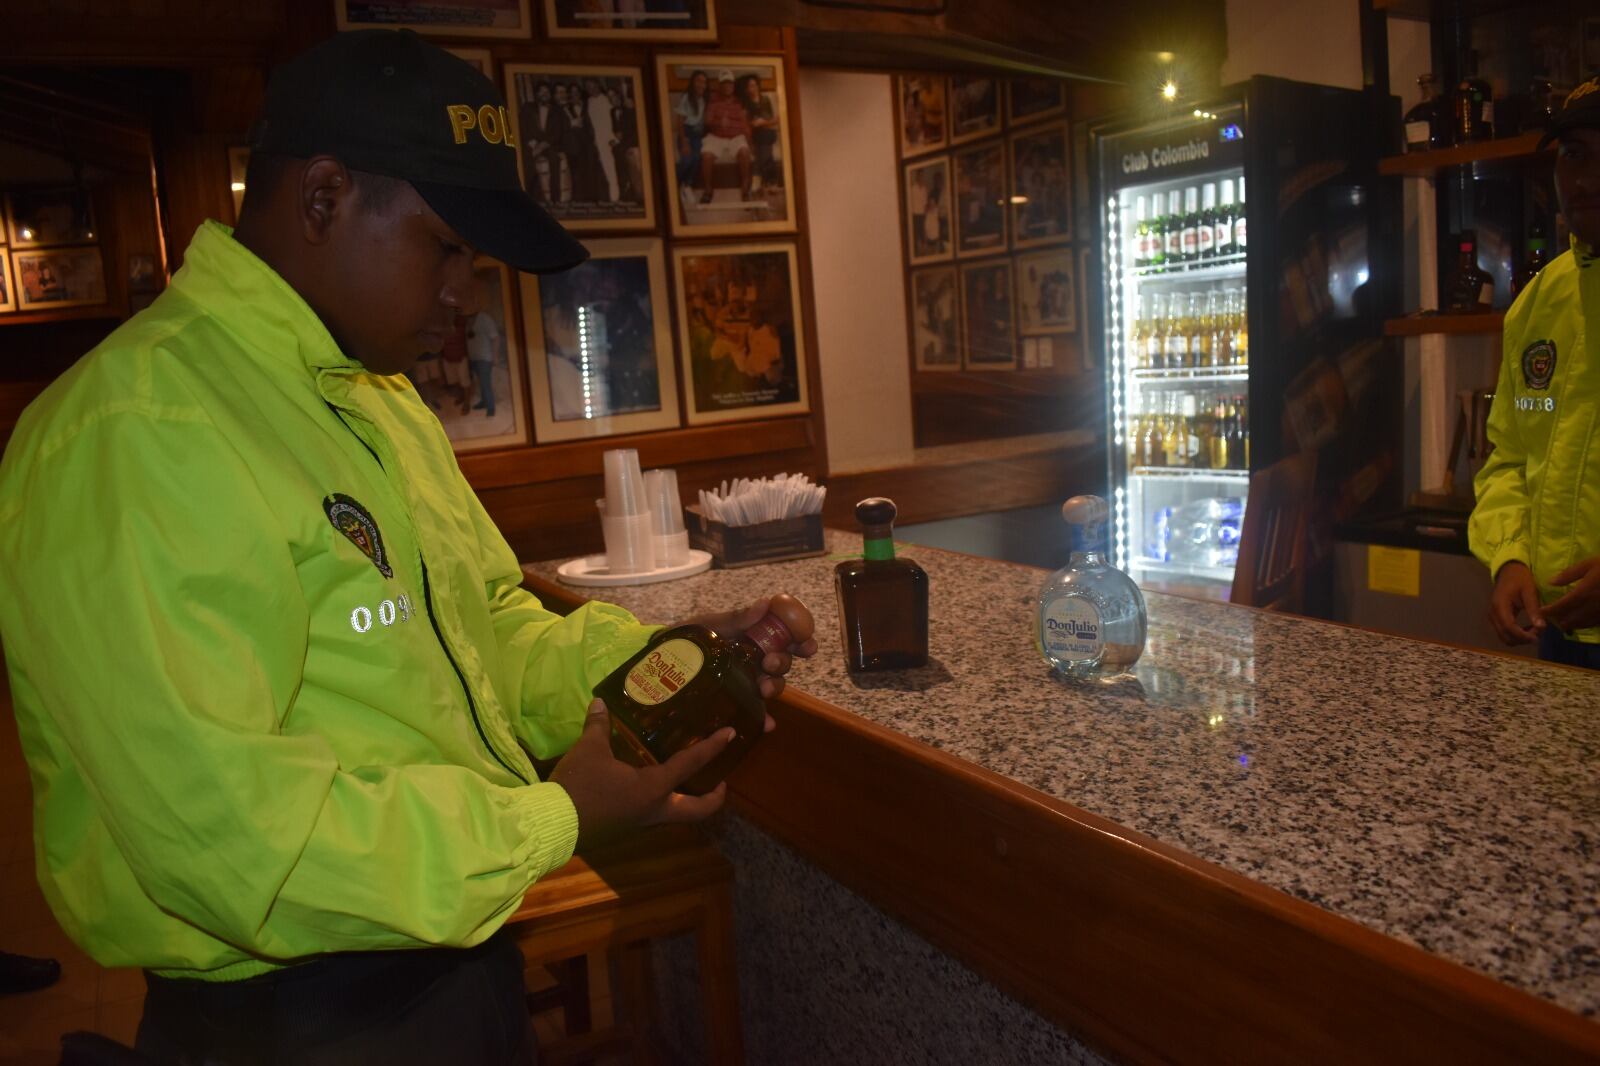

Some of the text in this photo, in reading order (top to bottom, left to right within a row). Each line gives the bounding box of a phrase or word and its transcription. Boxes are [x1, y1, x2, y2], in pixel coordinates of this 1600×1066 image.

[447, 104, 516, 148] POL
[1123, 139, 1209, 173] Club Colombia
